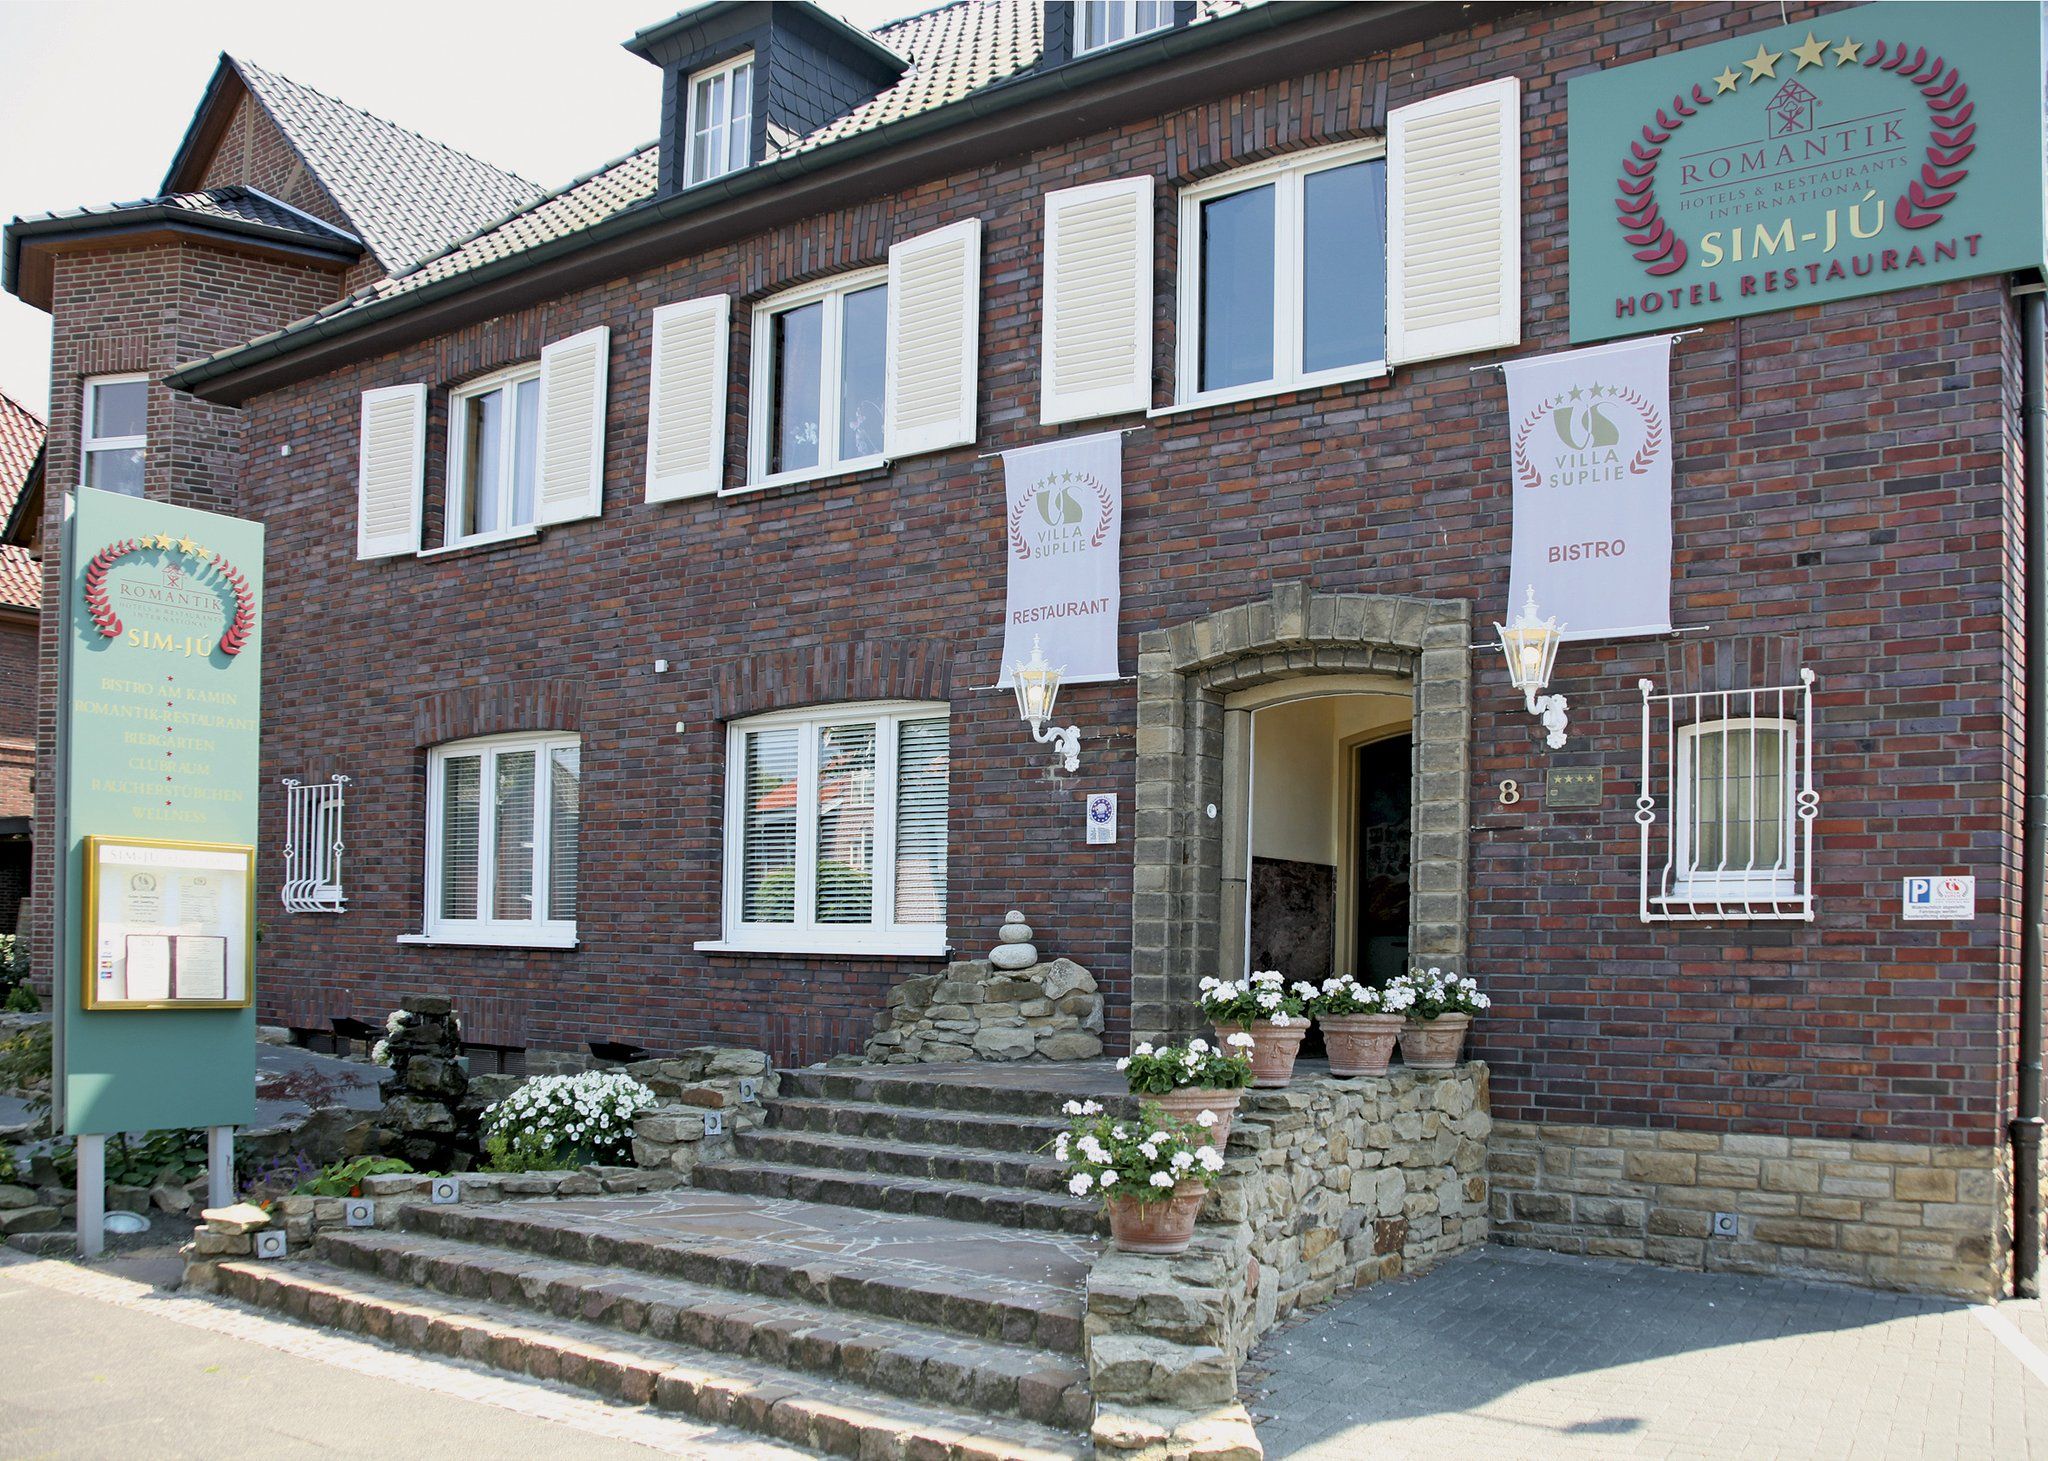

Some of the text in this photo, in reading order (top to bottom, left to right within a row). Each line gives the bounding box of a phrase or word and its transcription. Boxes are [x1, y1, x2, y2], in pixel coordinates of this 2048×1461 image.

[1681, 119, 1905, 186] ROMANTIK
[1680, 155, 1908, 211] HOTELS & RESTAURANTS
[1709, 180, 1875, 220] INTERNATIONAL
[1700, 189, 1886, 269] SIM-JÚ
[1615, 233, 1983, 319] HOTEL RESTAURANT
[1555, 448, 1619, 470] VILLA
[1550, 465, 1624, 489] SUPLIE
[1037, 525, 1083, 543] VILLA
[1035, 539, 1086, 559] SUPLIE
[1548, 539, 1626, 563] BISTRO
[120, 584, 220, 610] ROMANTIK
[1012, 598, 1110, 625] RESTAURANT
[128, 627, 212, 658] SIM-JÚ
[101, 677, 238, 705] BISTRO AM KAMIN
[74, 700, 257, 732] ROMANTIK-RESTAURANT
[124, 731, 216, 752] BIERGARTEN
[128, 757, 211, 776] CLUBRAUM
[1500, 779, 1520, 804] 8
[131, 806, 208, 824] WELLNESS
[1911, 879, 1929, 903] P
